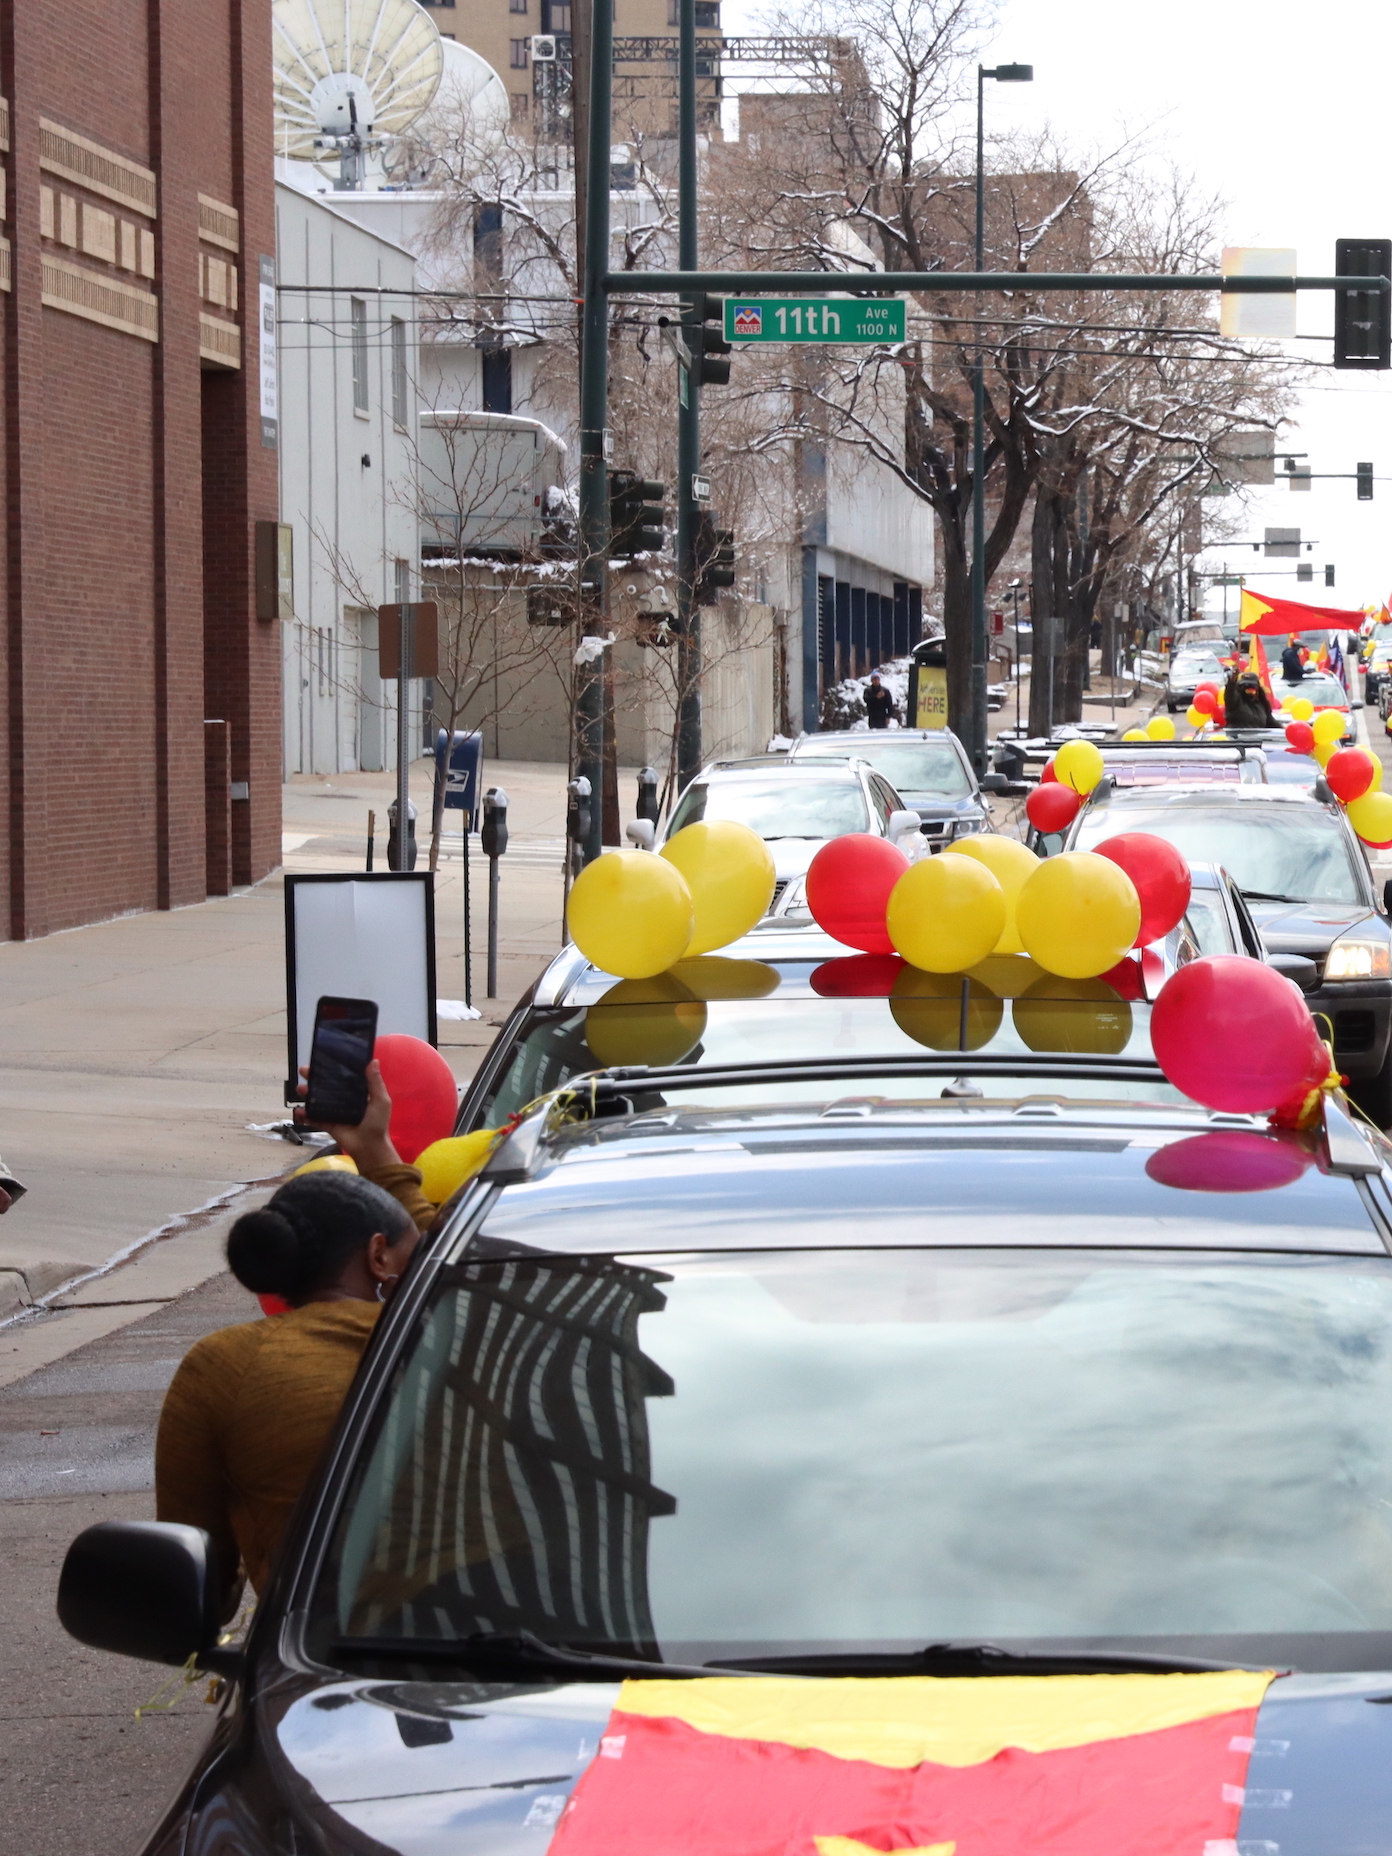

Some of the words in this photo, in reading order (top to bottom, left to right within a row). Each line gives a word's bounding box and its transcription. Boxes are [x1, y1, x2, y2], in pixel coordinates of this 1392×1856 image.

[865, 307, 889, 319] Ave
[775, 305, 841, 335] 11th
[735, 325, 761, 333] DENVER
[856, 323, 884, 336] 1100
[888, 323, 898, 336] N
[917, 696, 945, 714] HERE
